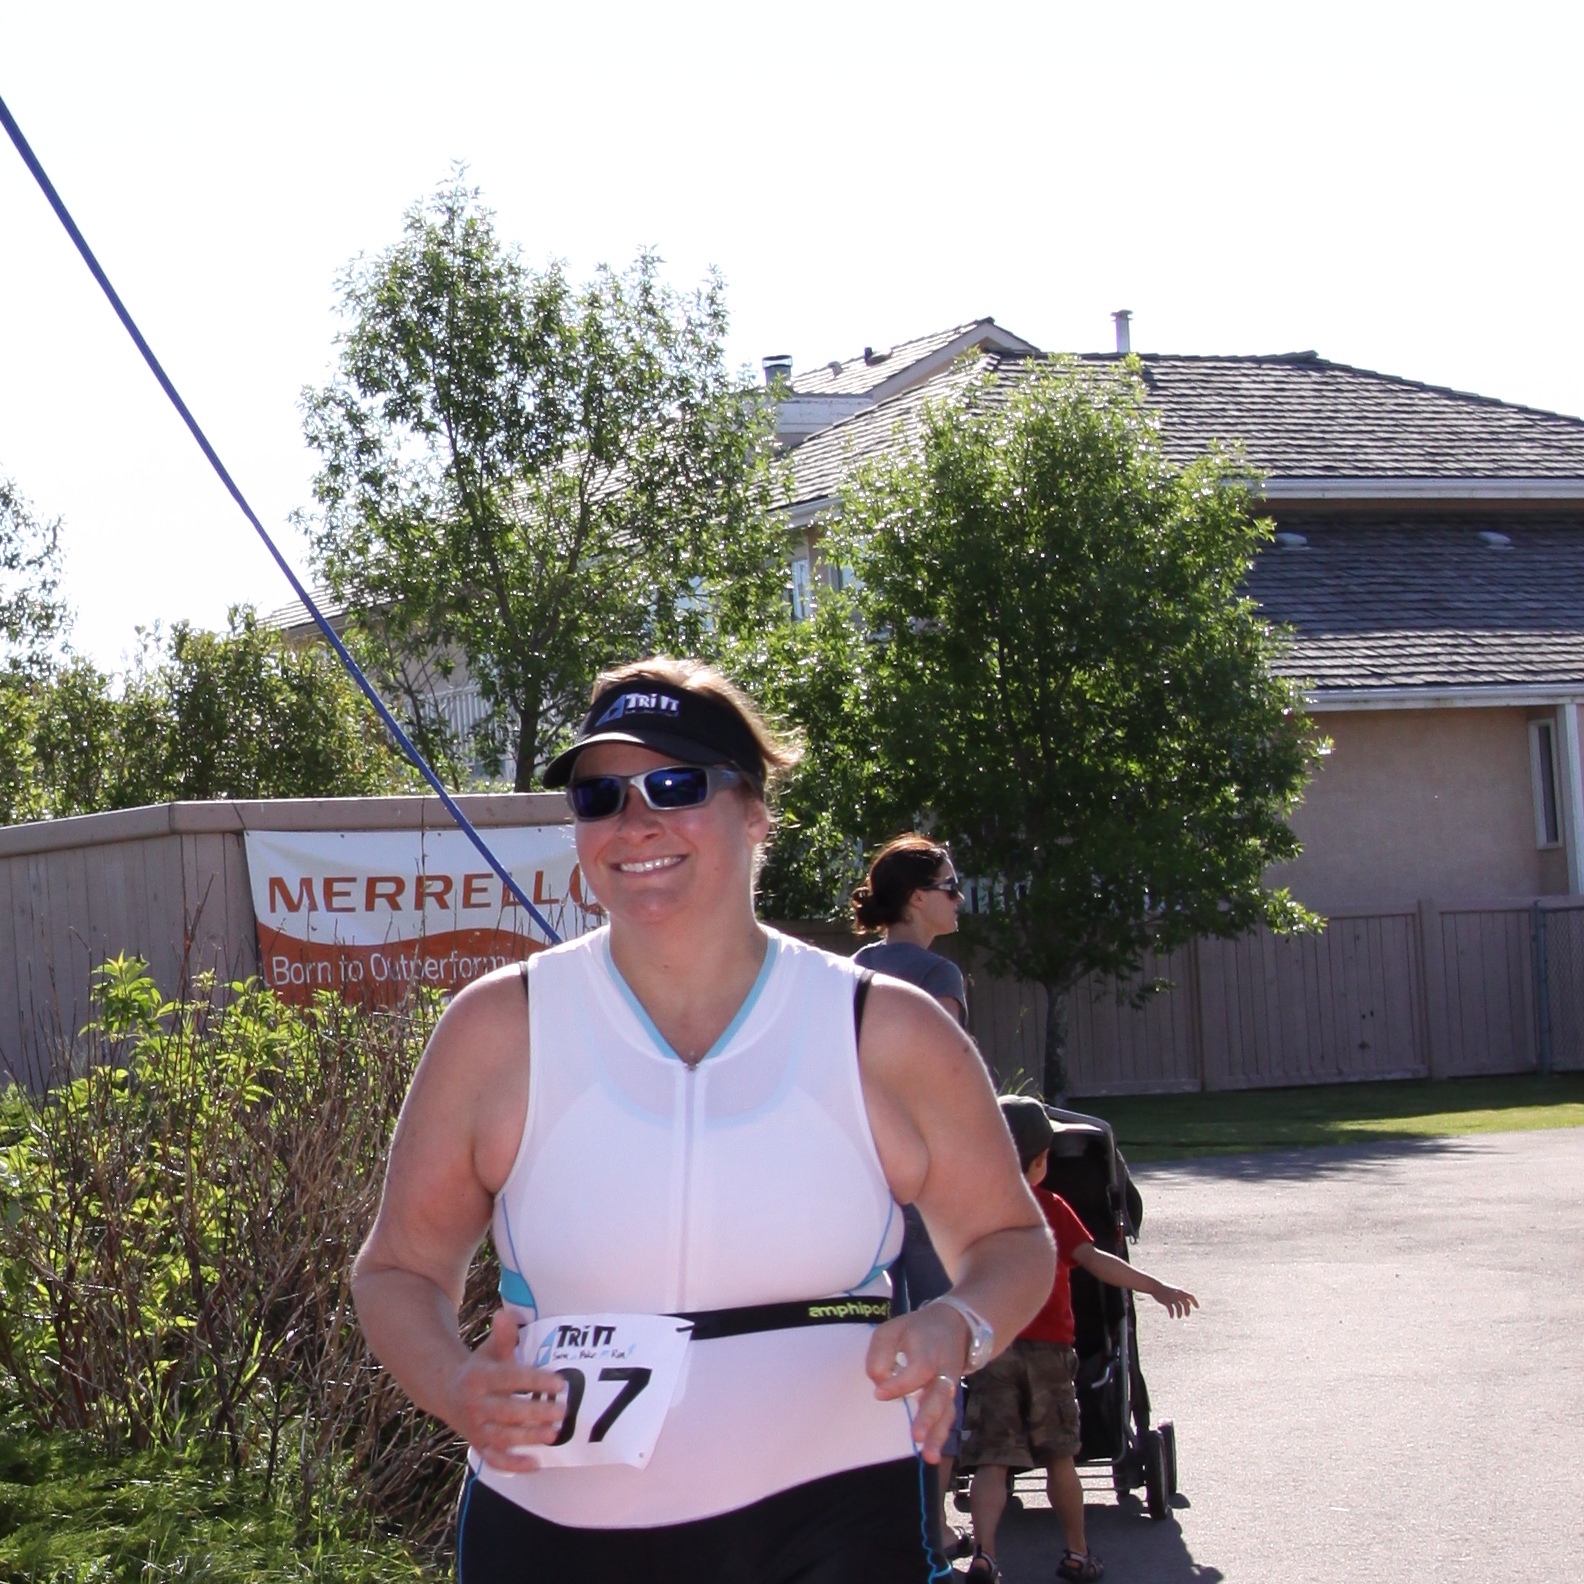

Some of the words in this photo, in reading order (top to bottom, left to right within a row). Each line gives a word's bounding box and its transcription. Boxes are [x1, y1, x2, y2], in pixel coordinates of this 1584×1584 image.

[268, 870, 560, 914] MERRELL
[272, 955, 332, 986] Born
[340, 954, 364, 983] to
